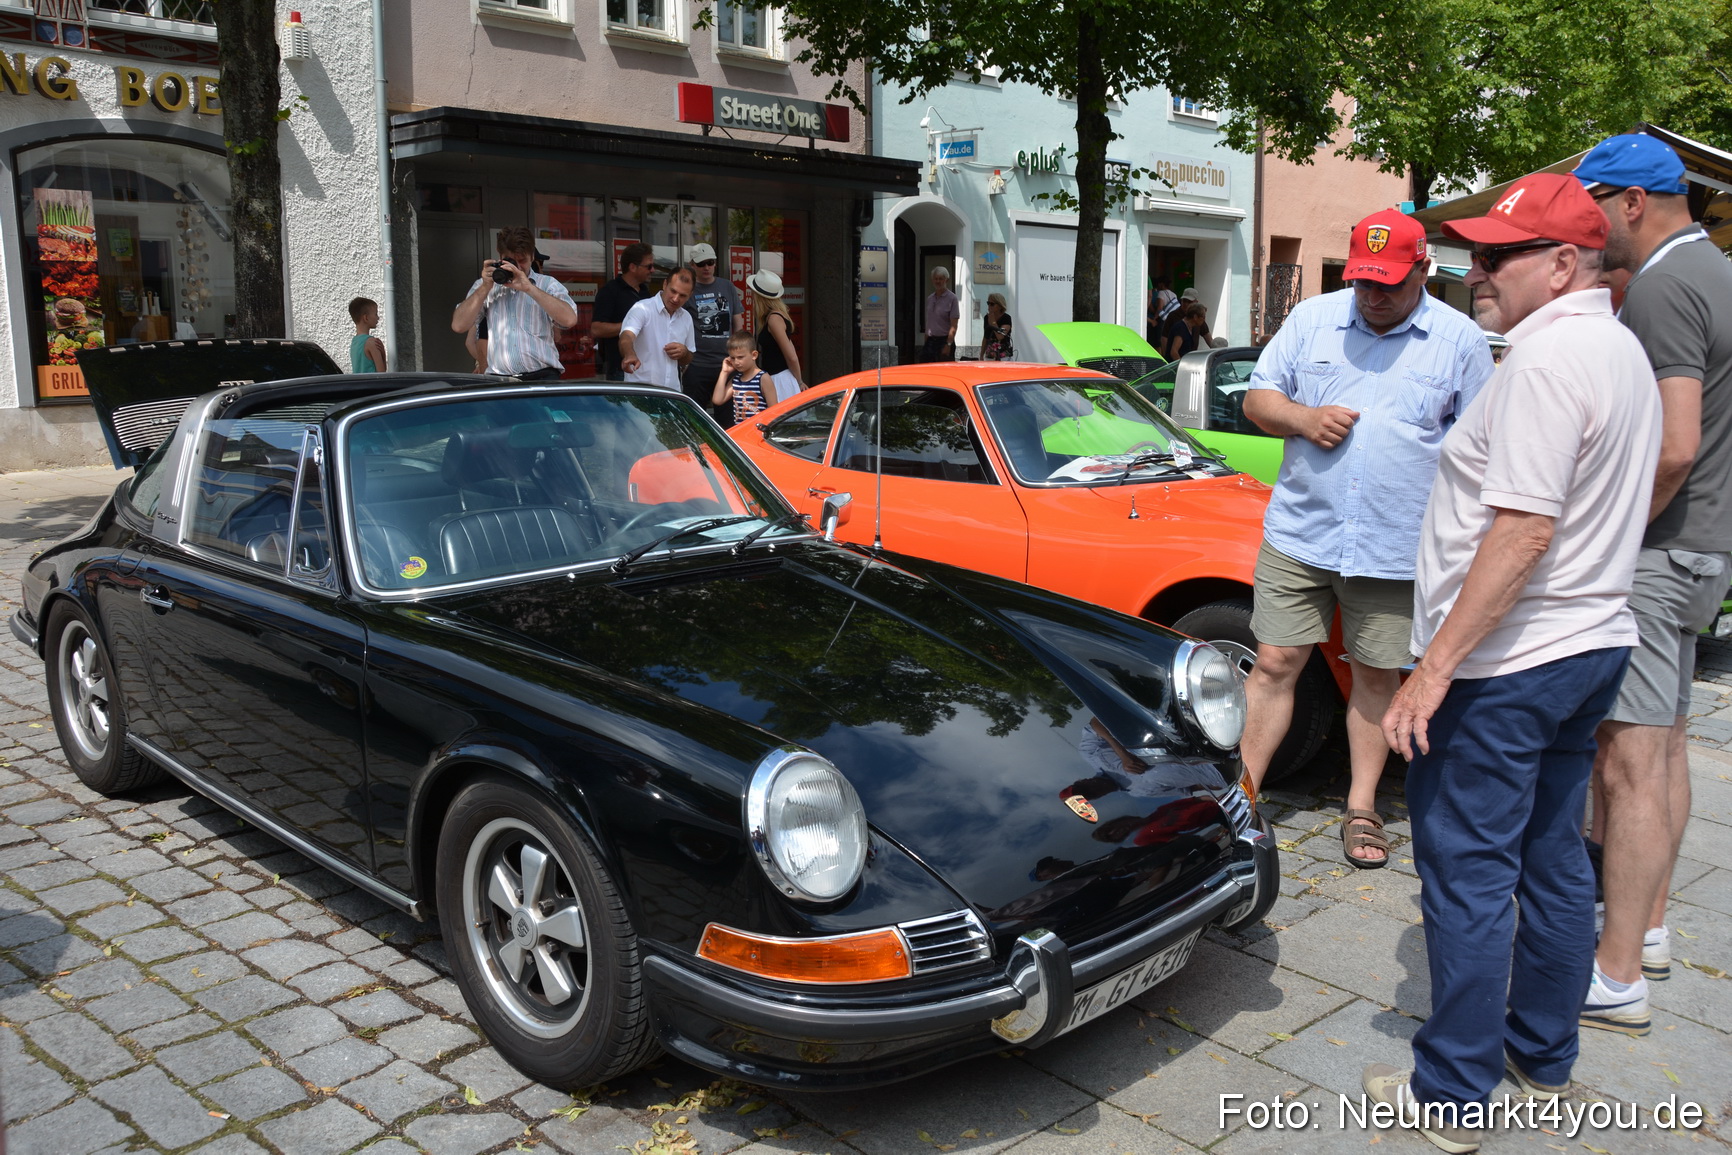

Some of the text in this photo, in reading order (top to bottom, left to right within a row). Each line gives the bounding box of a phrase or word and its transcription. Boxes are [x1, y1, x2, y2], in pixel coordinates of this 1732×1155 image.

[720, 95, 821, 131] Street One
[942, 144, 972, 156] blau.de
[1496, 187, 1526, 216] A
[1371, 243, 1380, 251] F1
[978, 263, 1002, 271] TROSCH
[1039, 273, 1049, 281] Wir
[1050, 274, 1066, 282] bauen
[1105, 963, 1146, 1009] GT
[1140, 931, 1200, 988] 431H
